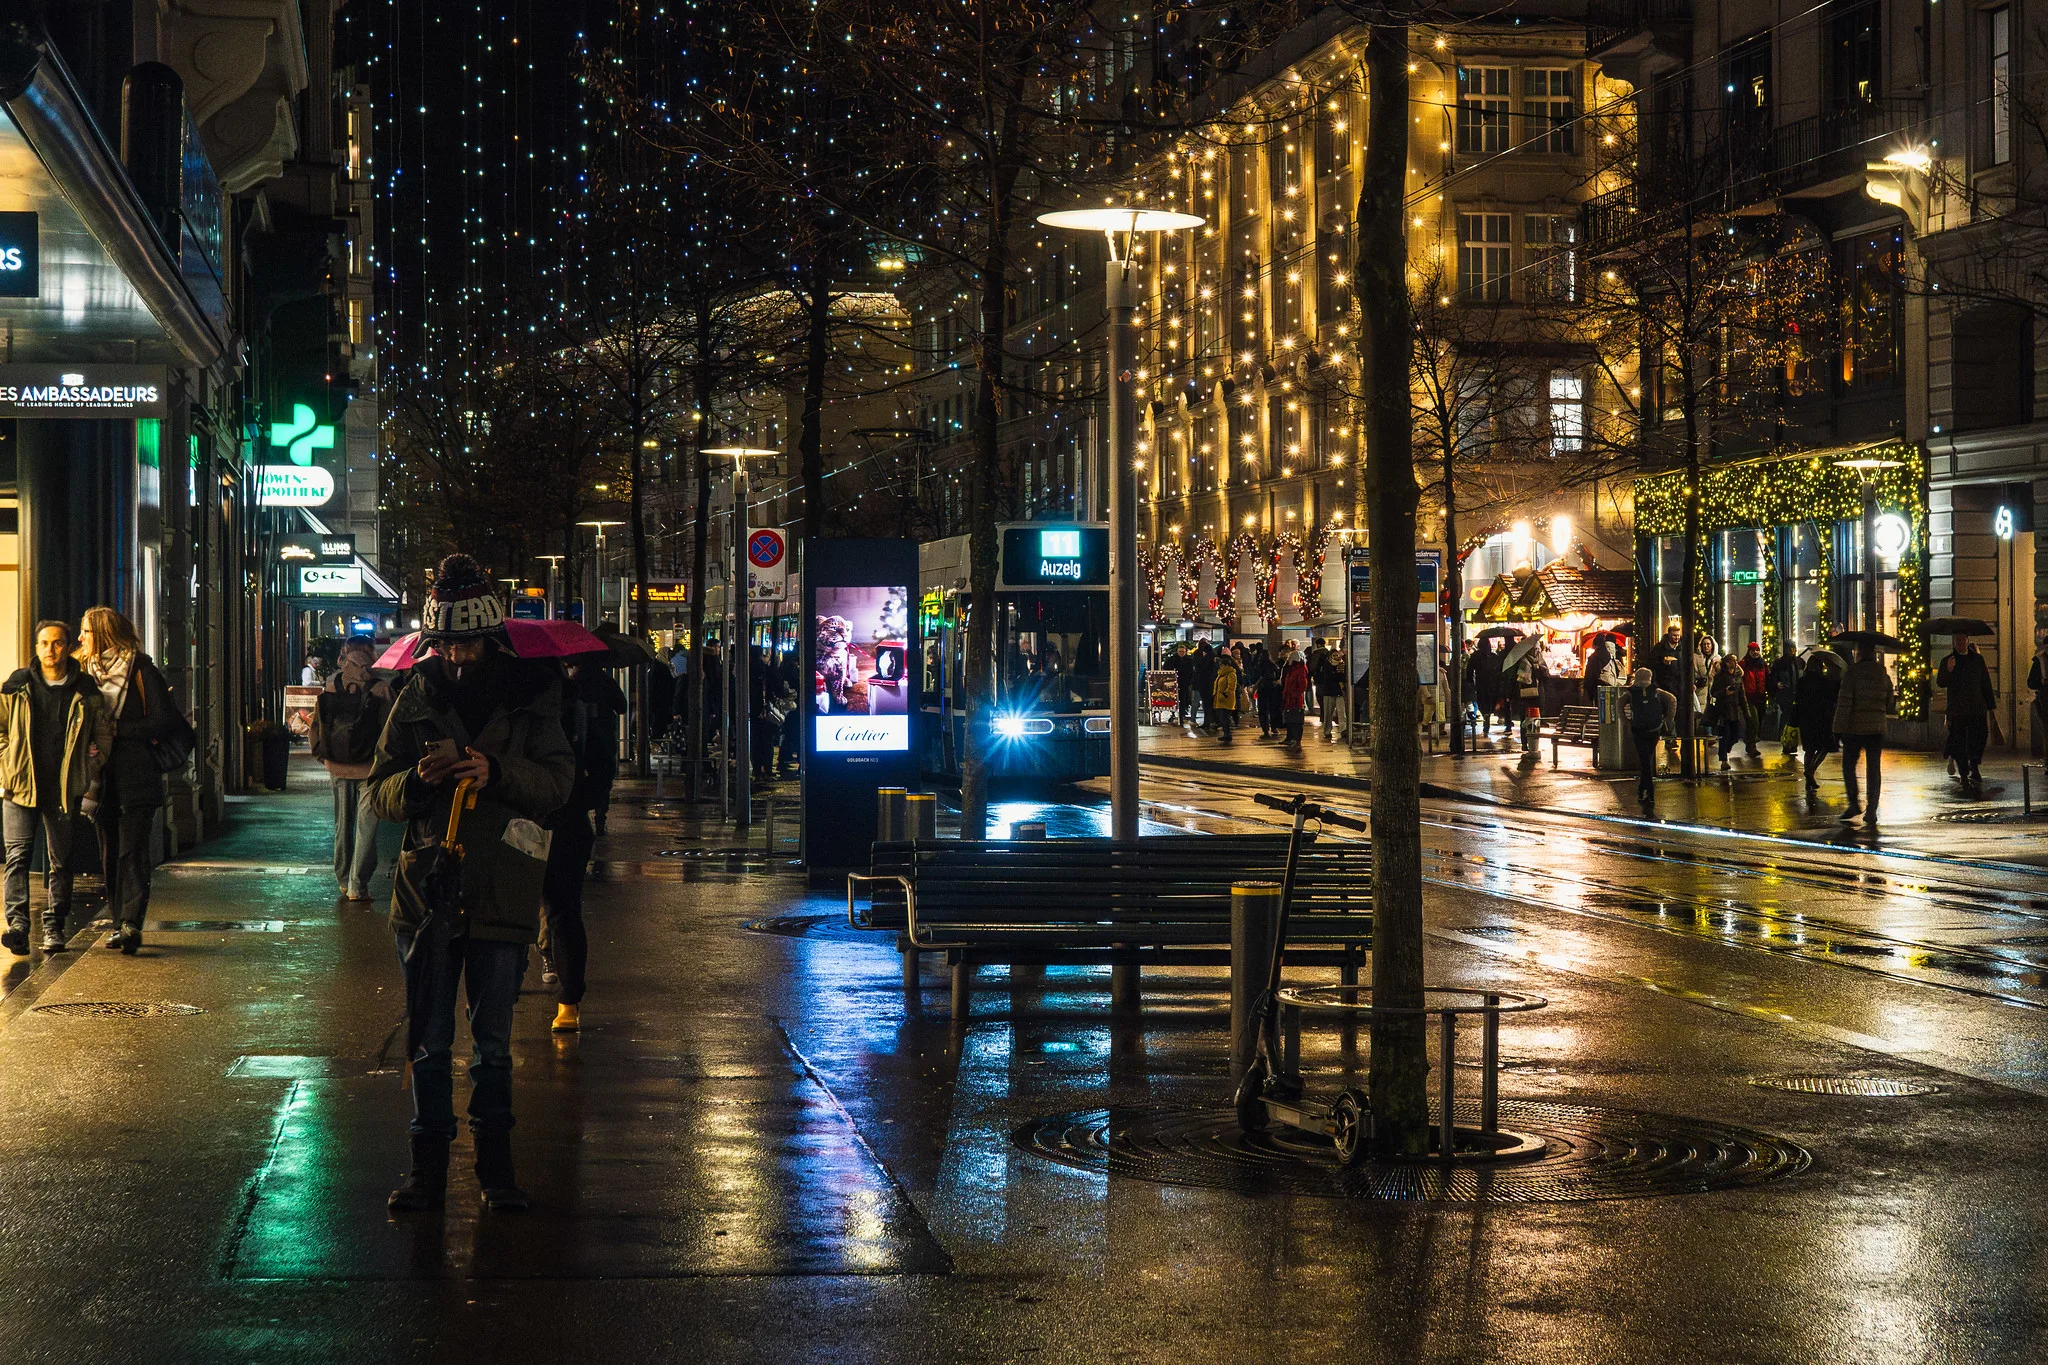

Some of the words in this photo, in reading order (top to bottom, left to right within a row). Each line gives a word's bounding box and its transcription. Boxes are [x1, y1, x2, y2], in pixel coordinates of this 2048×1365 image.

[21, 387, 158, 402] AMBASSADEURS
[1049, 533, 1073, 555] 11
[1040, 559, 1081, 579] Auzelg
[835, 726, 888, 741] Cartier
